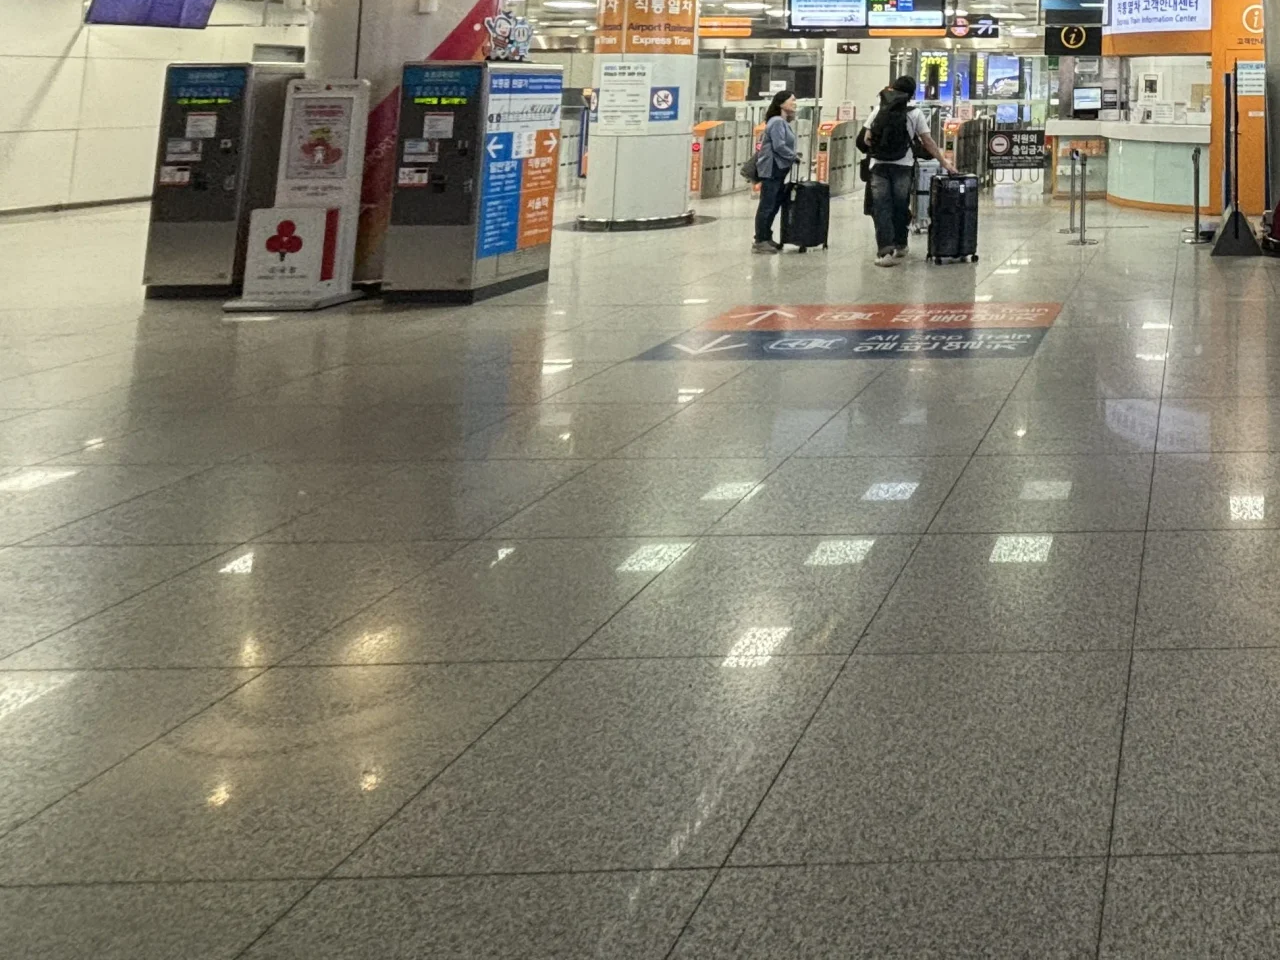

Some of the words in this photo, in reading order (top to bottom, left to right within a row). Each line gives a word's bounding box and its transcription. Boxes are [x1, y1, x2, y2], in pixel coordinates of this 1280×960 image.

[1175, 13, 1197, 23] Center
[628, 22, 661, 33] Airport
[632, 34, 672, 47] Express
[673, 35, 691, 47] Train
[1012, 133, 1037, 144] 직원외
[867, 333, 899, 341] All
